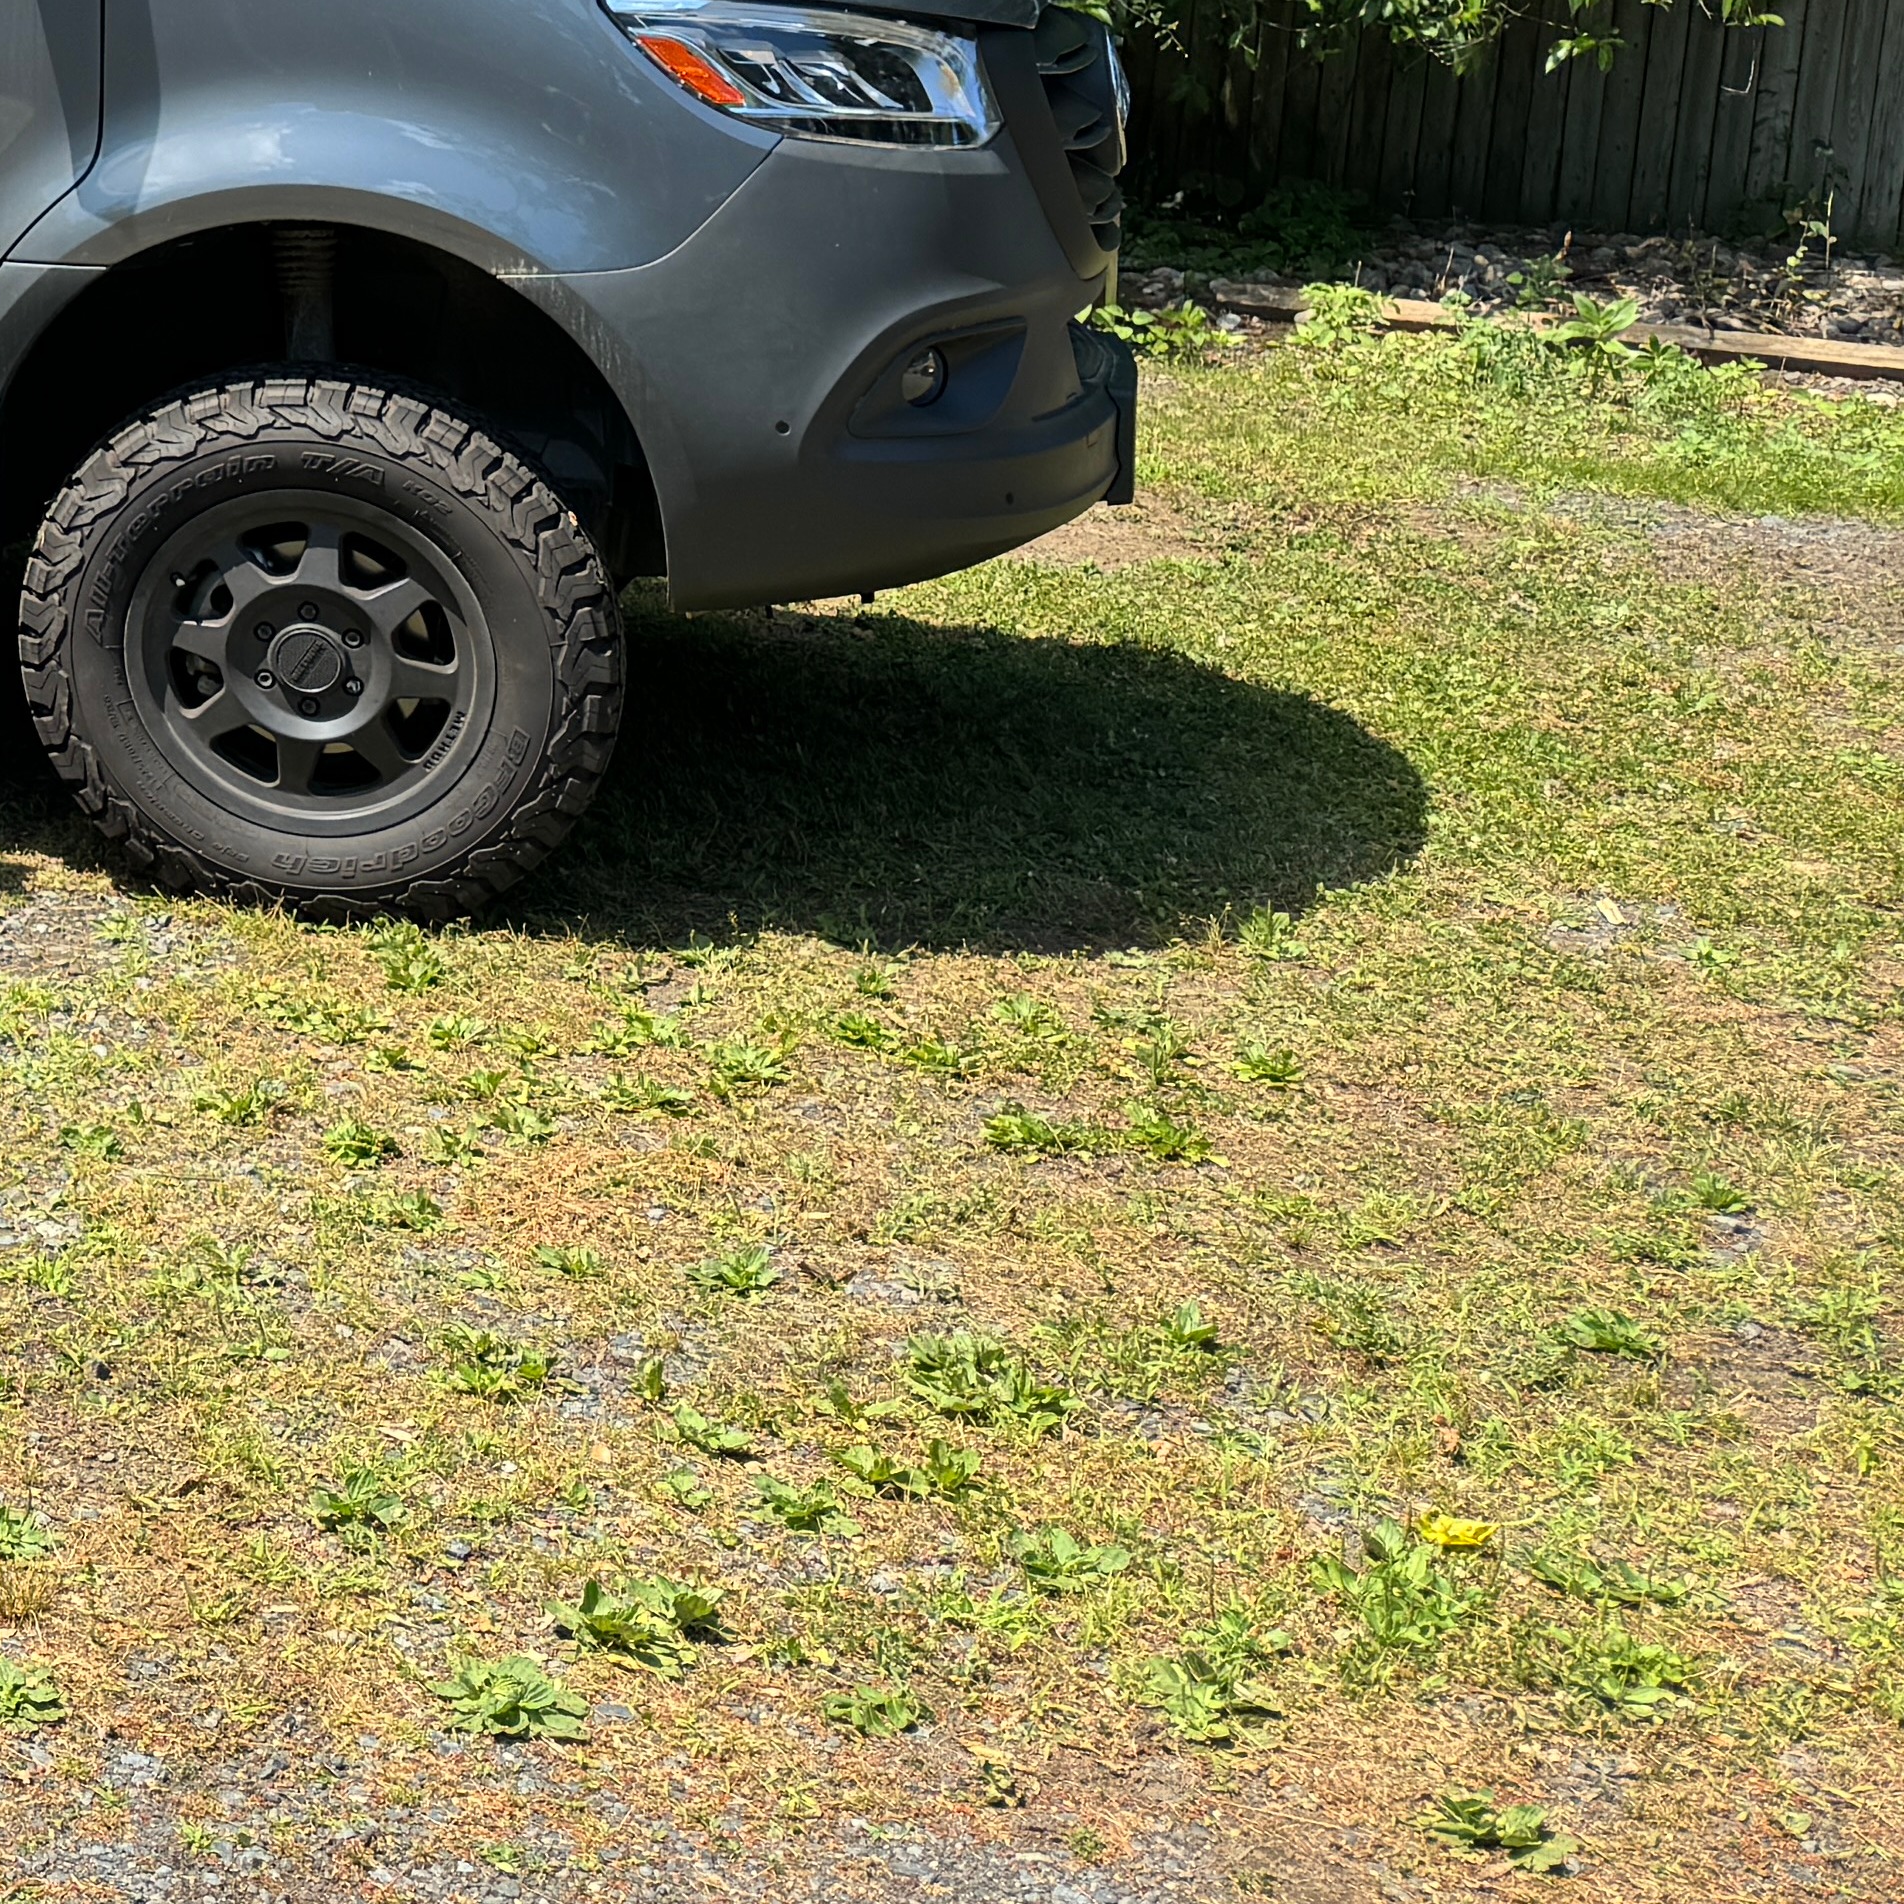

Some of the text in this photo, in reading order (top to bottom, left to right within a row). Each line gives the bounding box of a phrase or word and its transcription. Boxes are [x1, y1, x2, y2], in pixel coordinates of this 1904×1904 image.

[301, 451, 387, 488] T/A
[423, 710, 466, 770] METHOD
[272, 725, 532, 879] BFGoodrich
